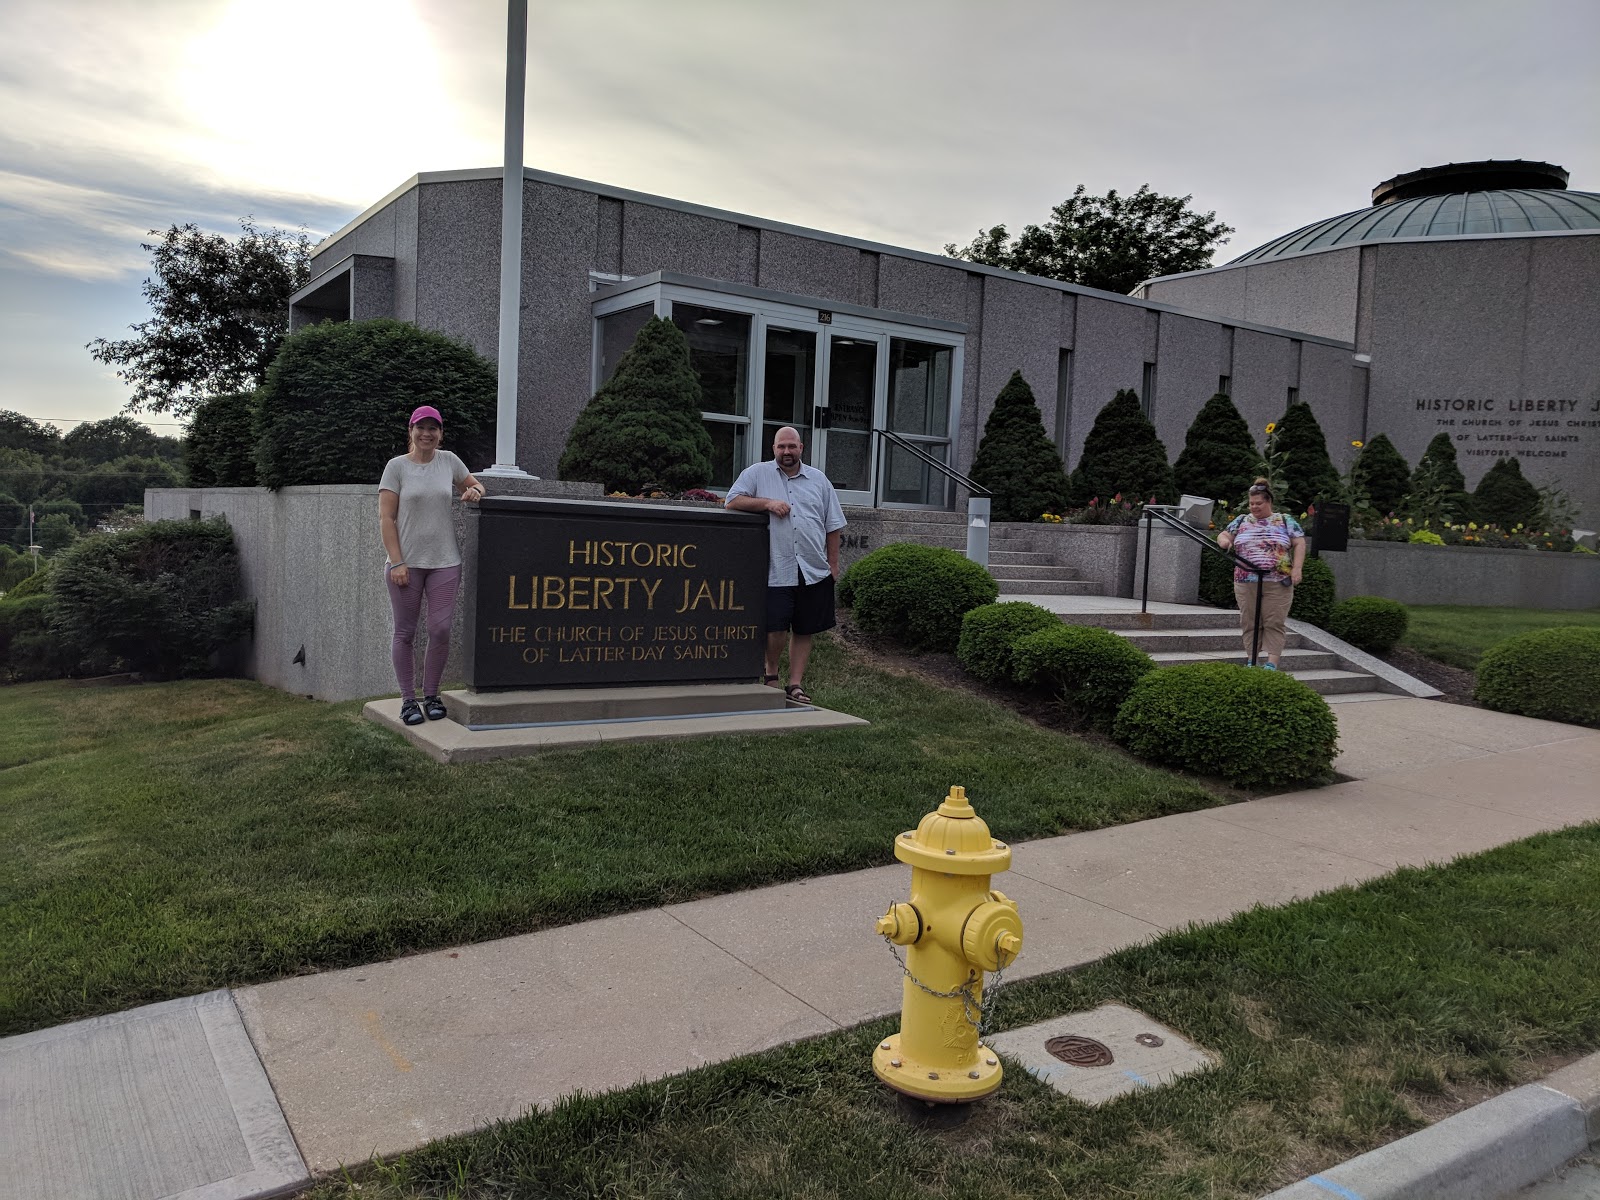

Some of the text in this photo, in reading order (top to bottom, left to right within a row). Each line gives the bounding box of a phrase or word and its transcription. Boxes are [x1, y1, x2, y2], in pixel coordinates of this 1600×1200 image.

[819, 312, 831, 322] 216
[1416, 399, 1494, 411] HISTORIC
[1509, 400, 1578, 412] LIBERTY
[1508, 419, 1522, 427] OF
[1477, 434, 1537, 442] LATTER-DAY
[1545, 435, 1579, 443] SAINTS
[1466, 449, 1568, 458] VISITORS WELCOME
[568, 540, 697, 568] HISTORIC
[508, 575, 745, 613] LIBERTY JAIL
[488, 625, 758, 643] THE CHURCH OF JESUS CHRIST
[522, 644, 729, 664] OF LATTER-DAY SAINTS
